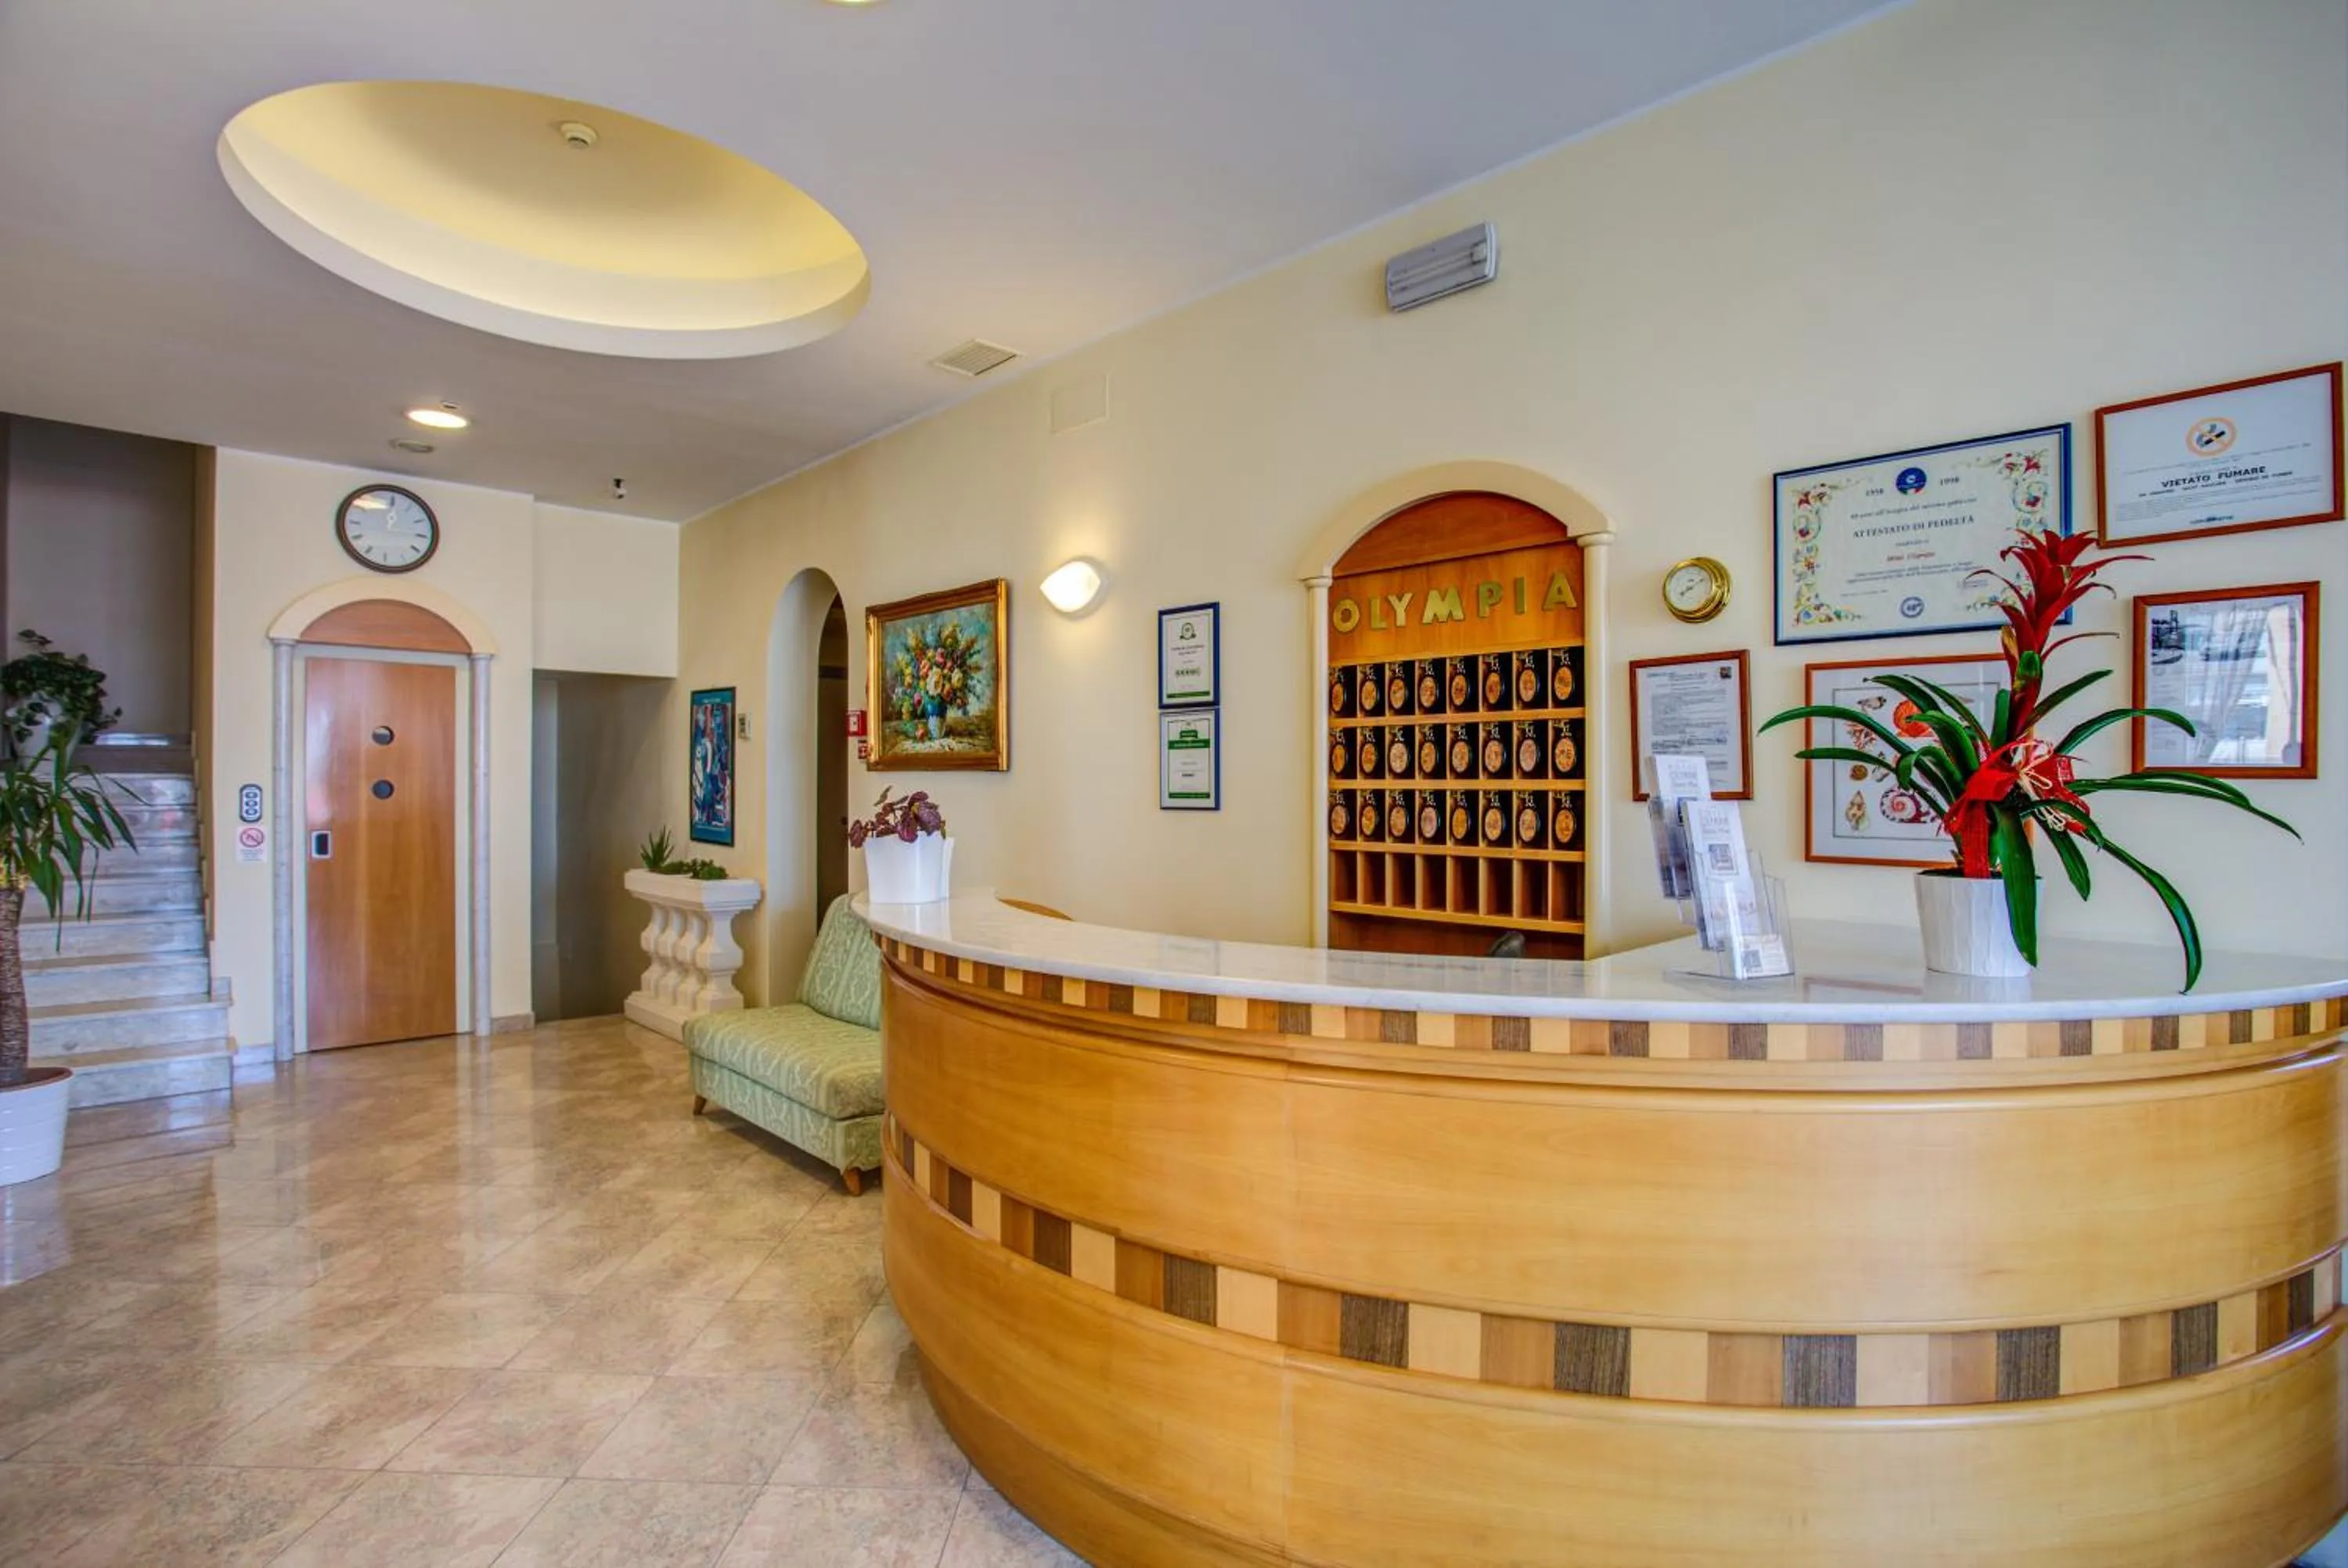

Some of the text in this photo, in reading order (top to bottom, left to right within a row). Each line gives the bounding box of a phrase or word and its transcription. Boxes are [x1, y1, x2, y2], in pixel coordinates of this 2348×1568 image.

[2161, 474, 2211, 487] VIETATO
[2217, 466, 2267, 480] FUMARE
[1332, 572, 1578, 633] OLYMPIA
